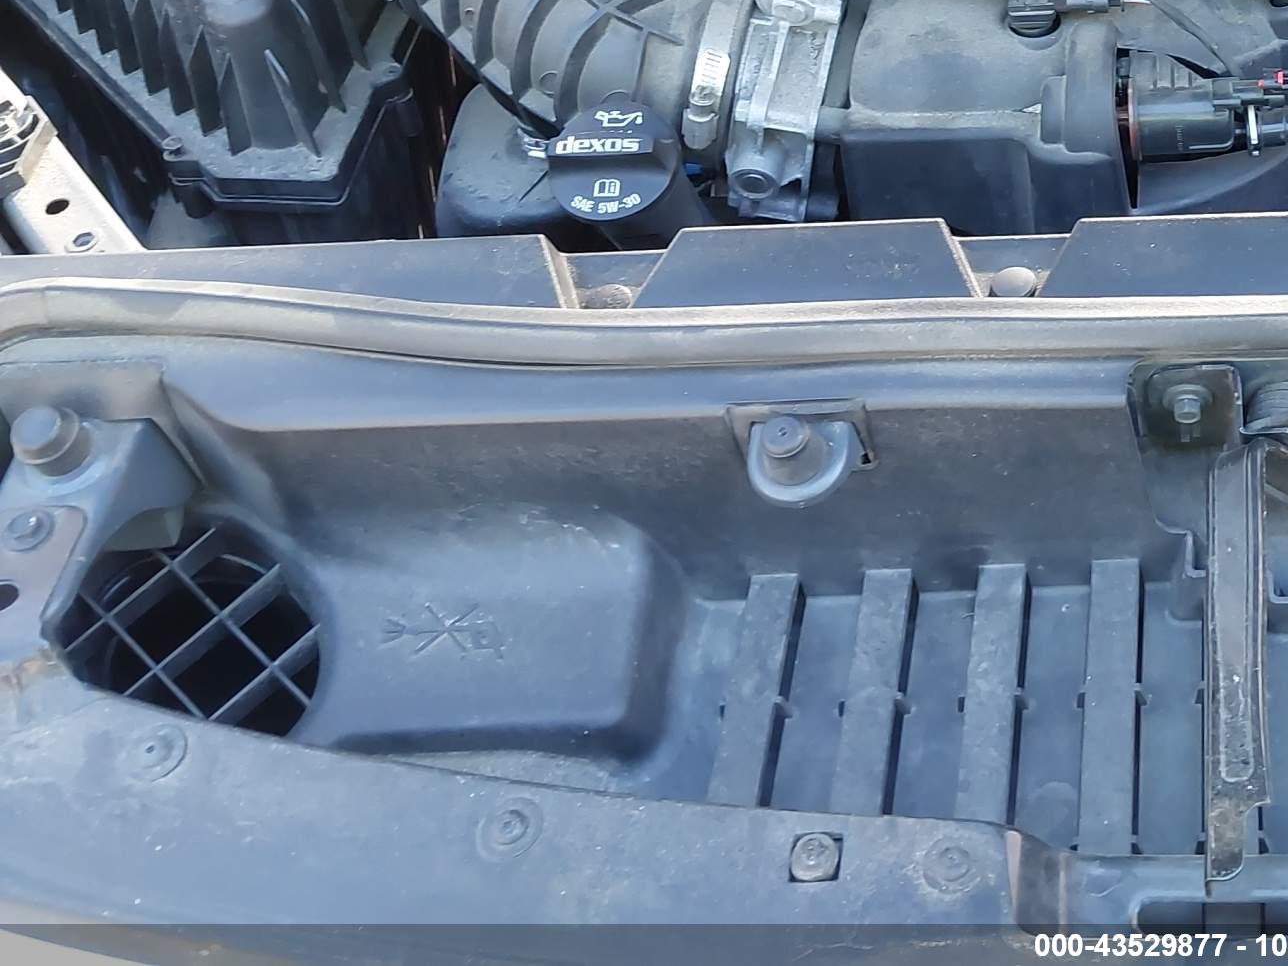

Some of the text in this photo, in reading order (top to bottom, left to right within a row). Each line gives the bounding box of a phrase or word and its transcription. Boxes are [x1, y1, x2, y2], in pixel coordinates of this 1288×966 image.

[556, 136, 641, 155] dexos
[571, 194, 641, 214] SAE 5W-30
